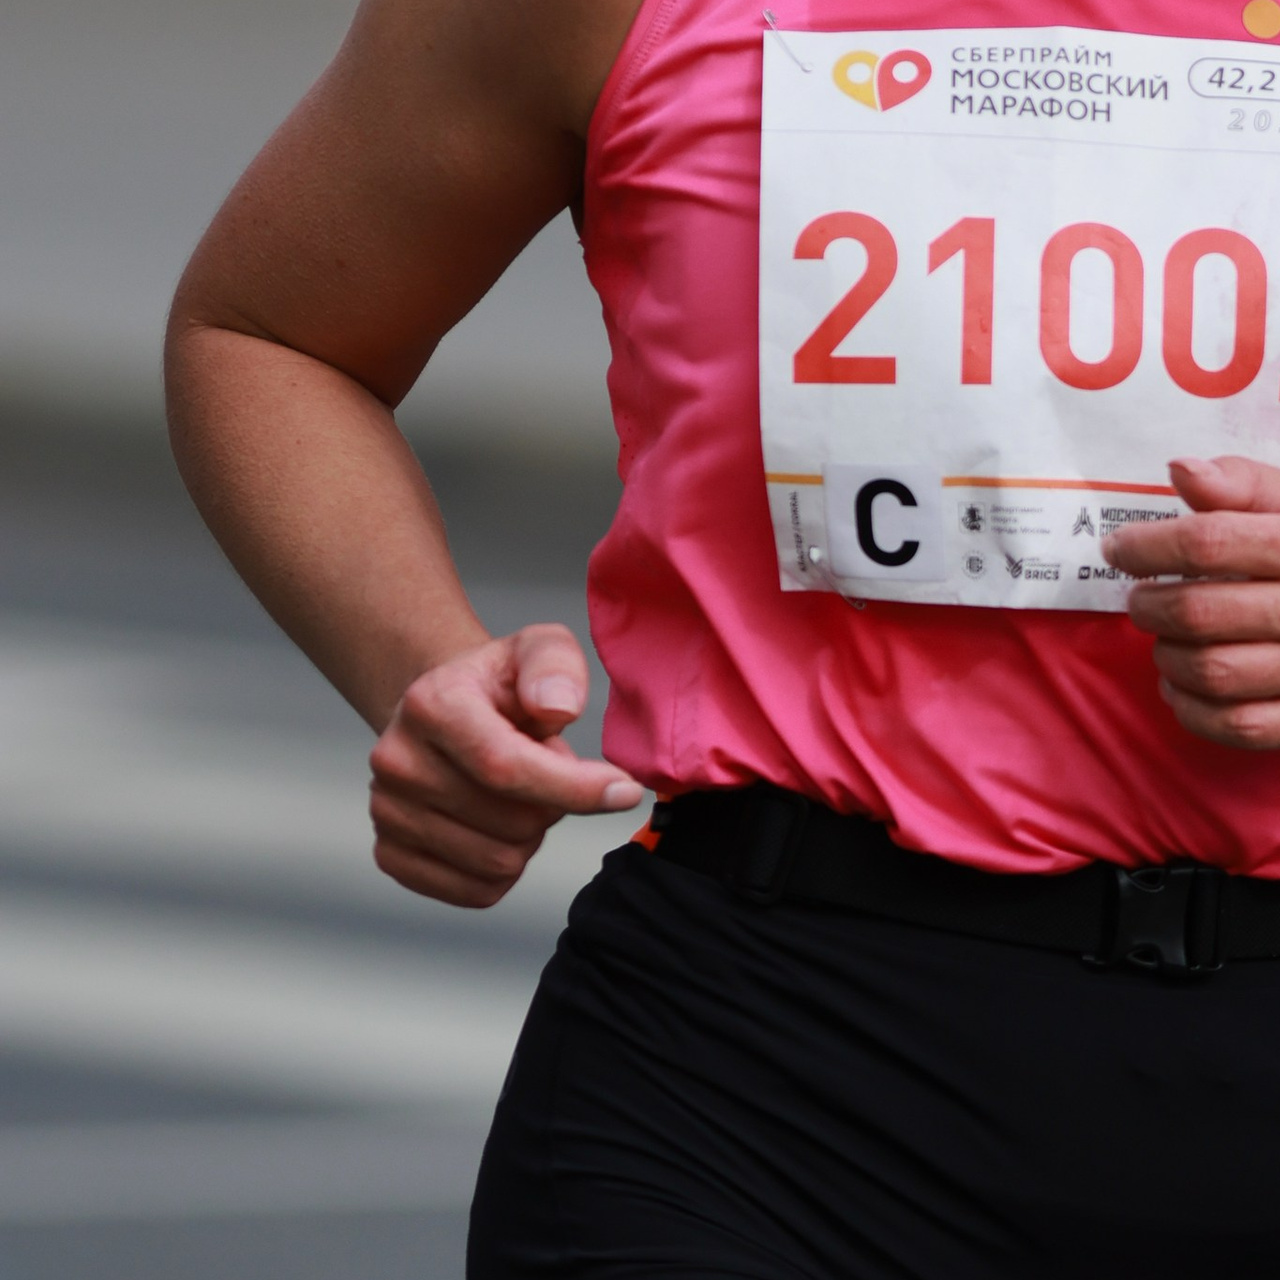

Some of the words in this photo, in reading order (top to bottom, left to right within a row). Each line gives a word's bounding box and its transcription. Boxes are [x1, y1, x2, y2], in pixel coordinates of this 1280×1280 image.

[952, 45, 1112, 67] СБЕРПРАЙМ
[951, 68, 1169, 100] МОСКОВСКИЙ
[1208, 67, 1276, 93] 42,2
[951, 95, 1111, 122] МАРАФОН
[1025, 569, 1059, 580] BRICS
